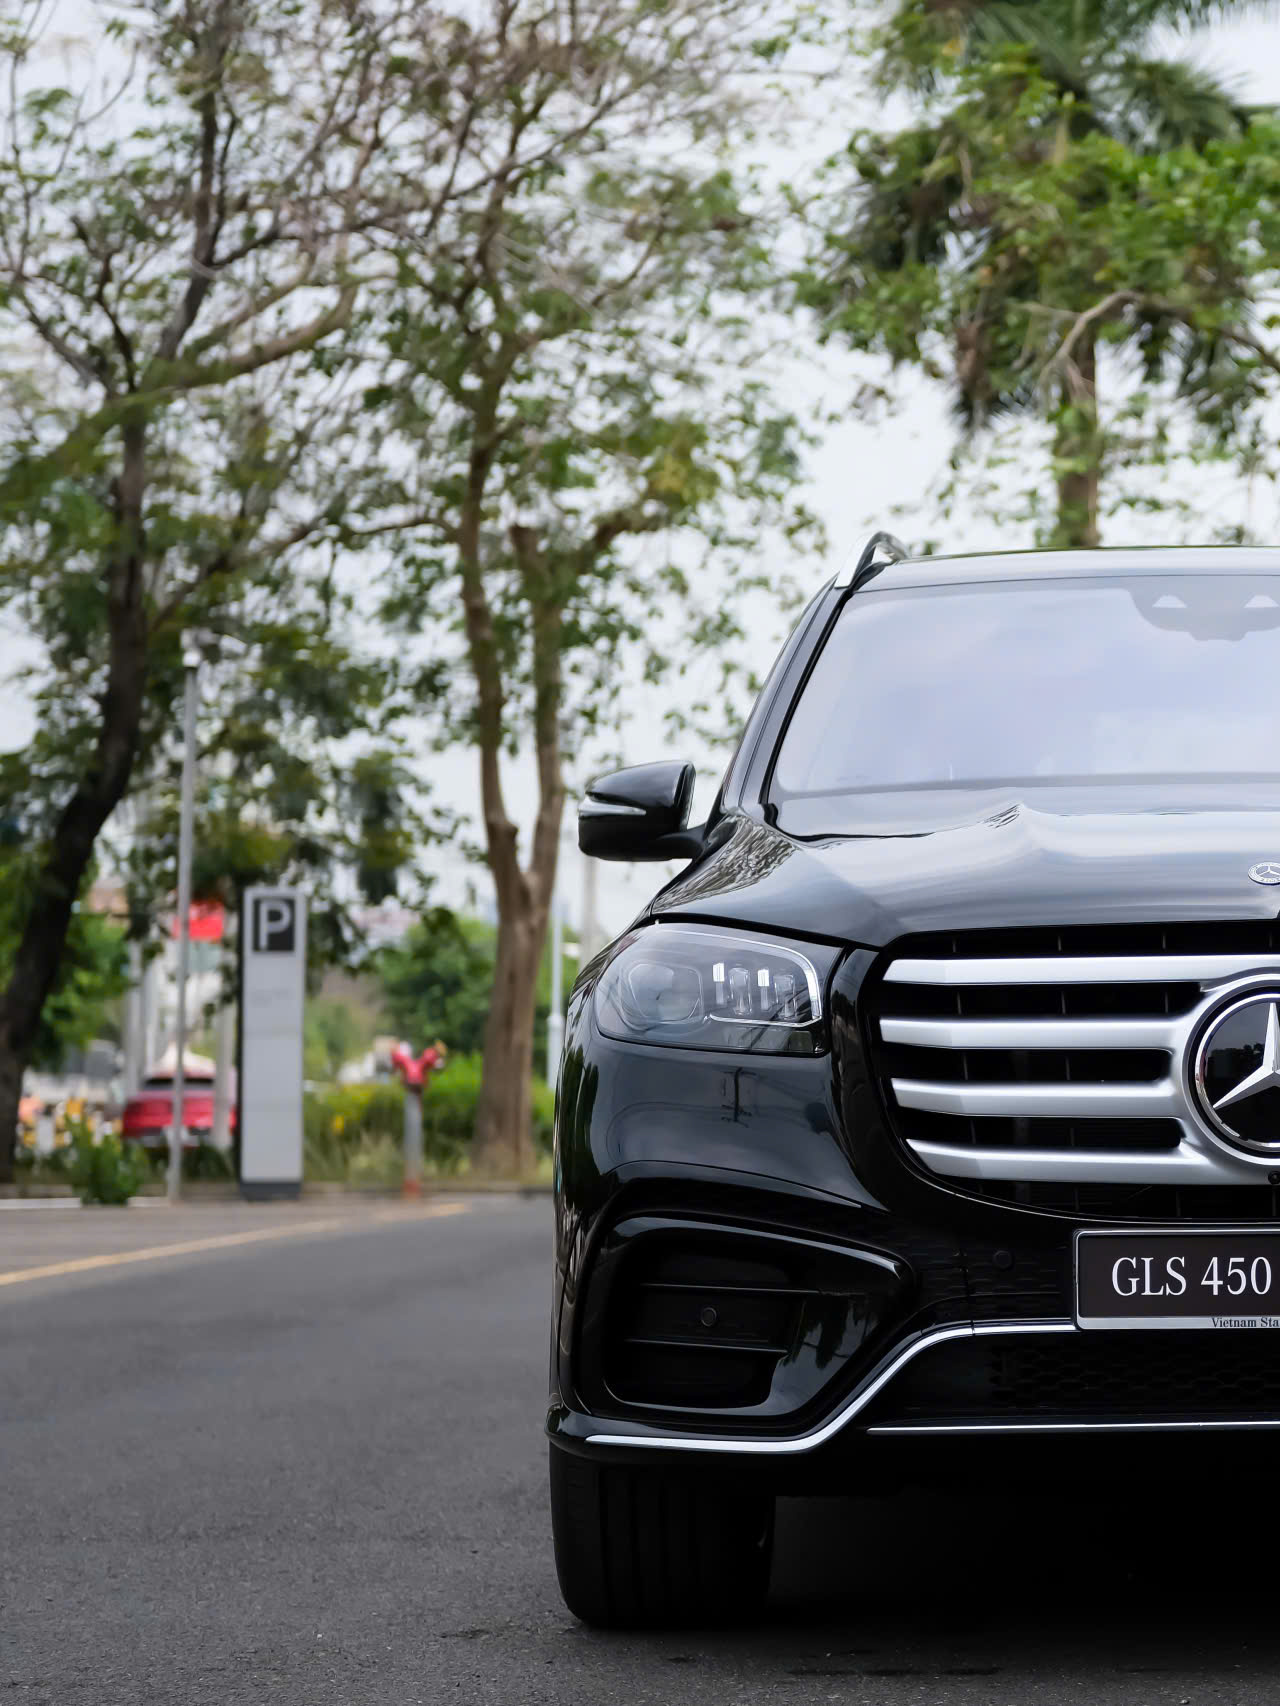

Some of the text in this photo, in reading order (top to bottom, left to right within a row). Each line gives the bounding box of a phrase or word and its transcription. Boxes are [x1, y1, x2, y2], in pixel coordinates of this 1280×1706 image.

[260, 901, 291, 949] P
[1111, 1256, 1187, 1296] GLS
[1201, 1256, 1272, 1295] 450
[1211, 1317, 1257, 1328] Vietnam
